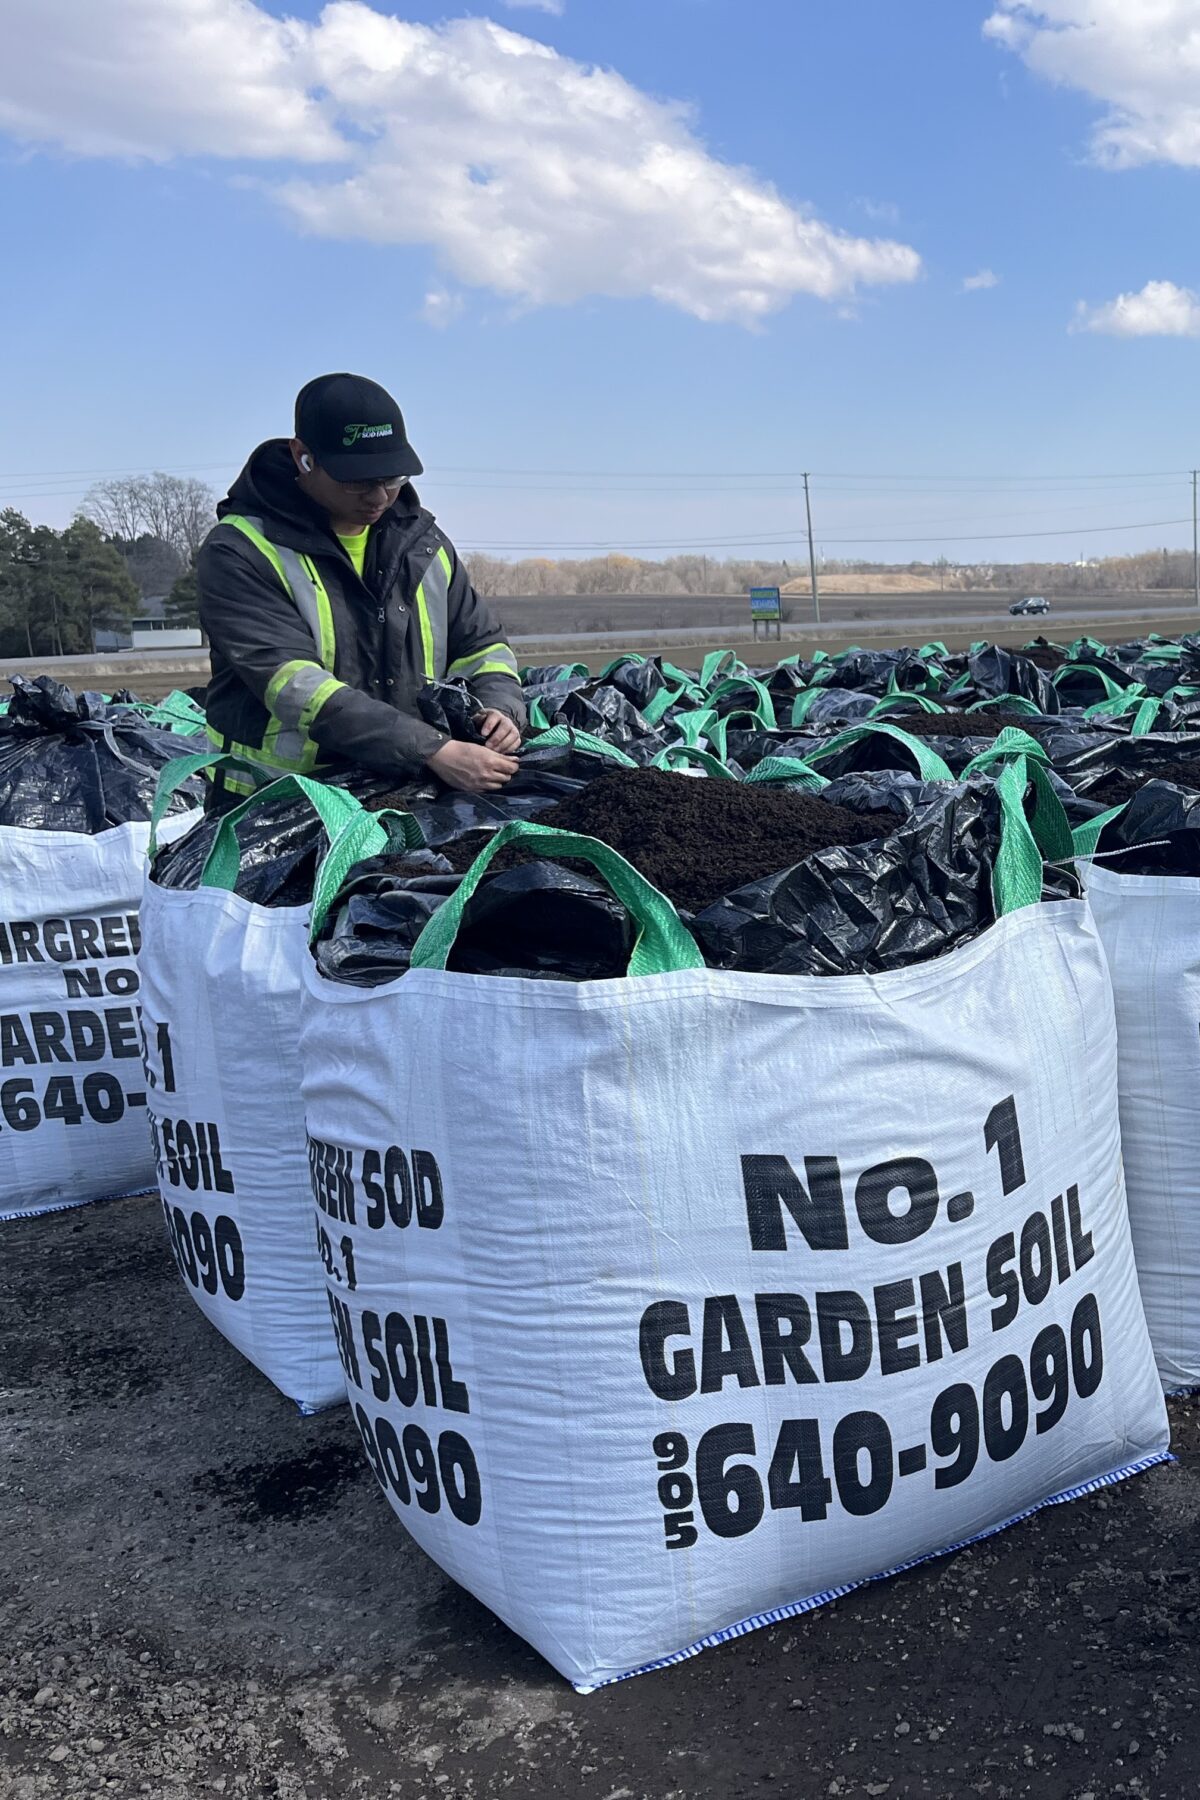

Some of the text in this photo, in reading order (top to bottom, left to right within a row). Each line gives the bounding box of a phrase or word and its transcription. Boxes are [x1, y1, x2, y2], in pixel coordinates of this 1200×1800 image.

[0, 1006, 142, 1066] ARDE
[161, 1118, 235, 1194] SOIL
[361, 1145, 444, 1230] SOD
[983, 1094, 1027, 1197] 1
[638, 1182, 1096, 1402] GARDEN SOIL
[361, 1310, 471, 1414] SOIL
[652, 1292, 1104, 1551] 905 640-9090
